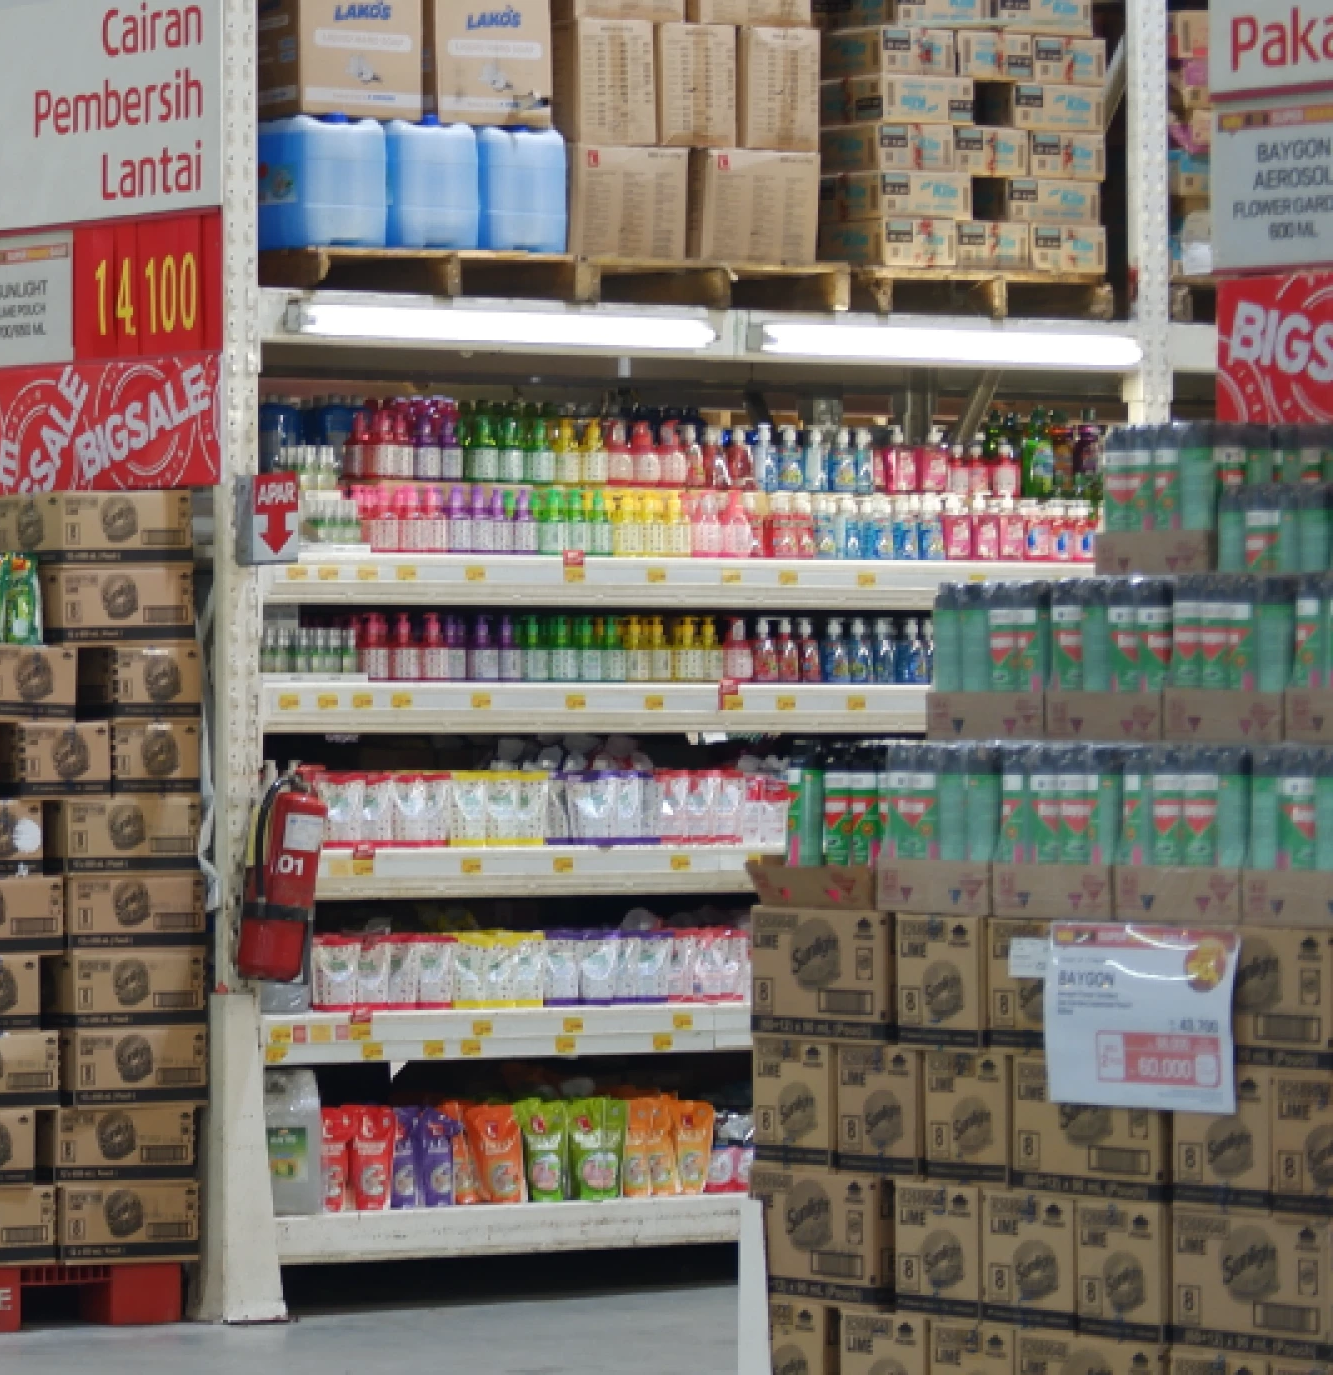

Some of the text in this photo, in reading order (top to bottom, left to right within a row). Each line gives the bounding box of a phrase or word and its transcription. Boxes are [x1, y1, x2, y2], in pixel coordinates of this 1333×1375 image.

[102, 2, 203, 57] Cairan
[34, 67, 203, 138] Pembersih
[102, 139, 203, 200] Lantai
[1256, 137, 1332, 164] BAYGON
[1252, 165, 1333, 191] AEROSOL
[75, 362, 212, 481] BIGSALE
[258, 482, 296, 506] APAR
[1057, 969, 1115, 987] BAYGON
